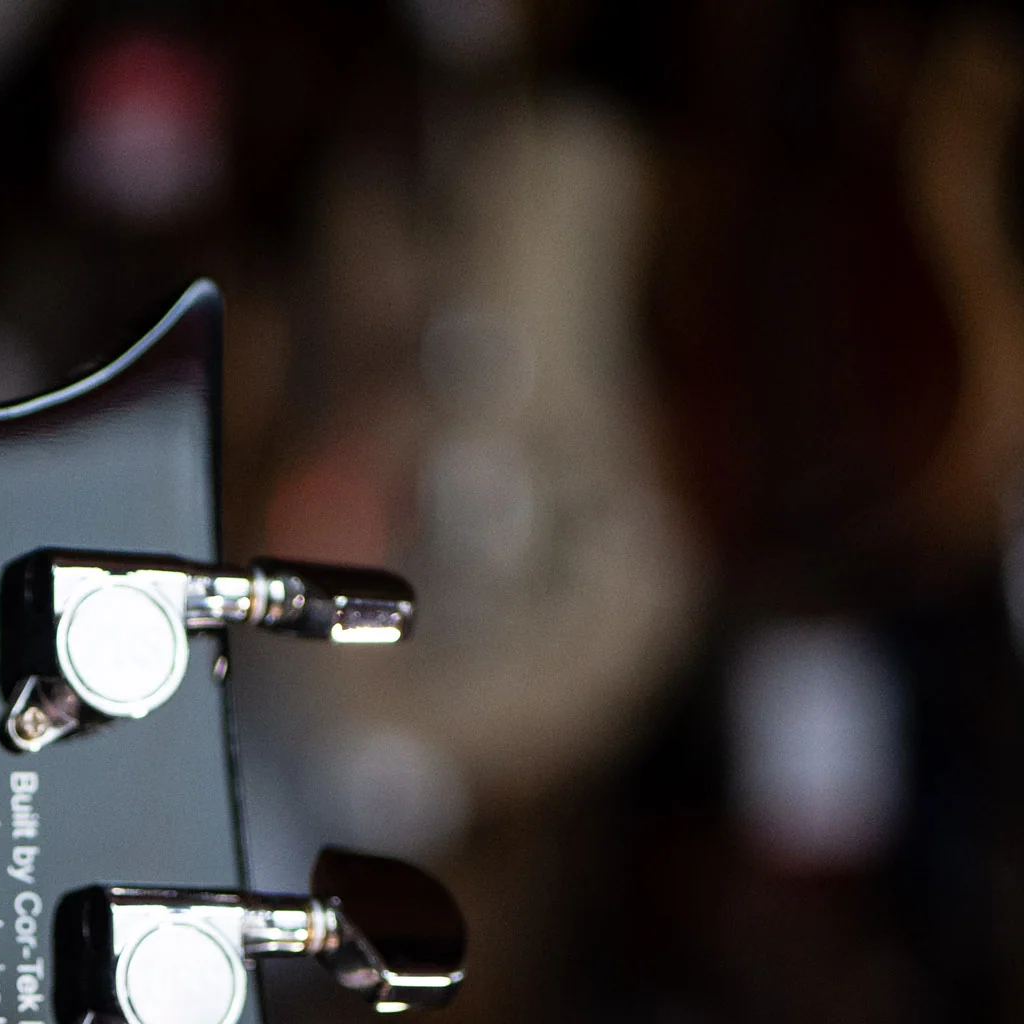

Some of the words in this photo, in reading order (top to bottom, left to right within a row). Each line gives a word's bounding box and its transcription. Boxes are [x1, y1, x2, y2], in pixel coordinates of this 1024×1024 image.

[10, 771, 40, 839] Built
[7, 846, 41, 884] by
[14, 891, 45, 1013] Cor-Tek
